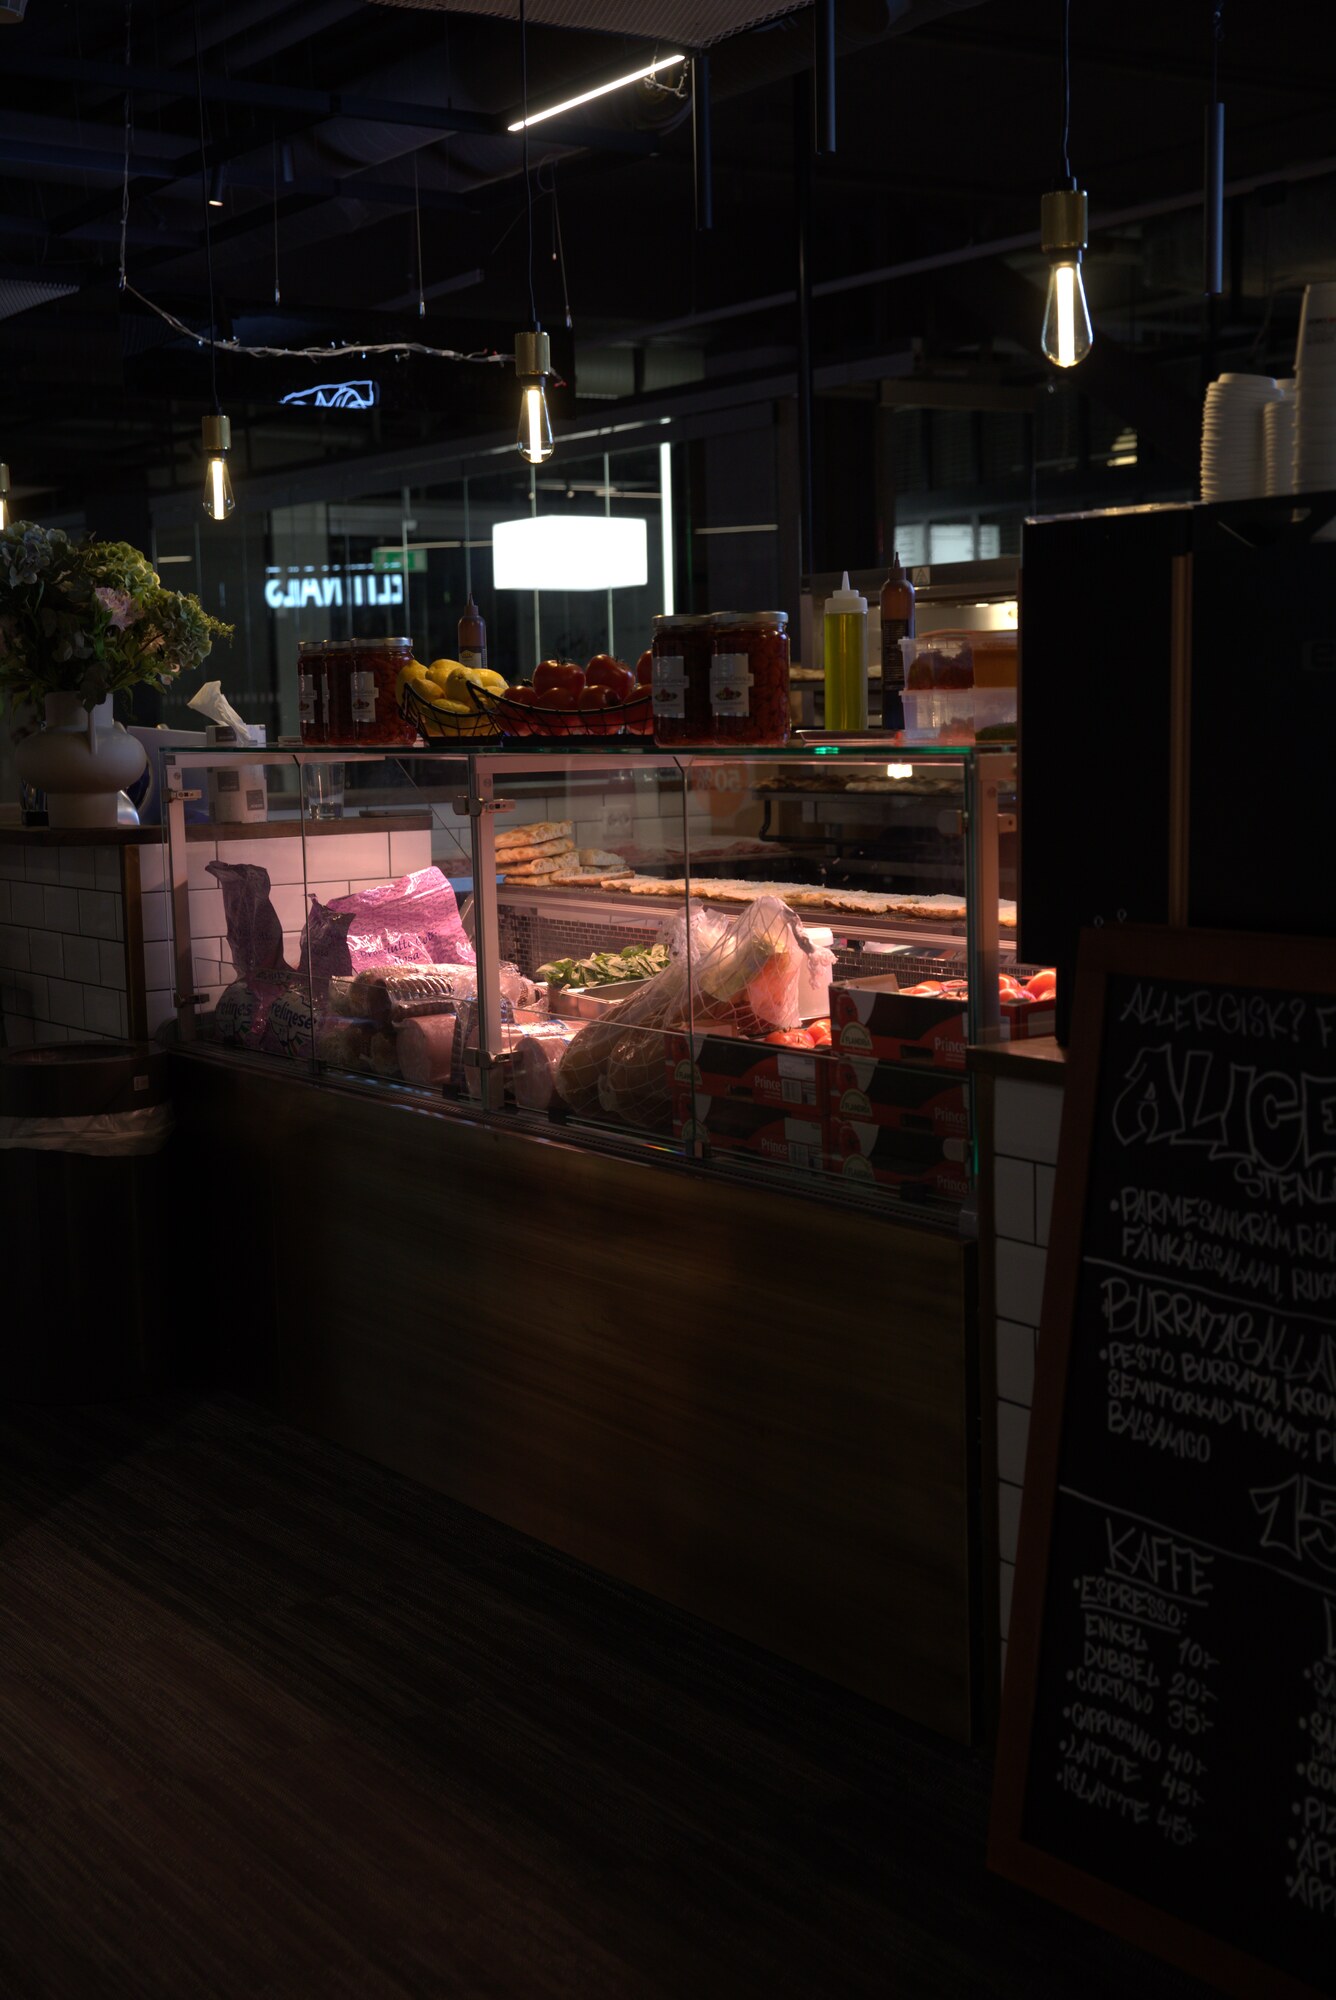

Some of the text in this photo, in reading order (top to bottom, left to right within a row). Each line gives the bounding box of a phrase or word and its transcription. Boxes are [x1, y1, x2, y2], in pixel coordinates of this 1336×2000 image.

[1119, 982, 1306, 1043] ALLERGISK?
[934, 1036, 966, 1054] Prince
[754, 1074, 781, 1092] Prince
[934, 1106, 966, 1124] Prince
[761, 1137, 788, 1155] Prince
[937, 1175, 969, 1194] Prince
[1234, 1159, 1336, 1206] STENL
[1108, 1341, 1177, 1379] PESTO,
[1108, 1370, 1233, 1425] SEMITORKAD
[1108, 1401, 1211, 1463] BALSAMICO
[1105, 1516, 1215, 1596] KAFFE
[1080, 1575, 1189, 1628] ESPRESSO:
[1085, 1612, 1149, 1652] ENKEL
[1084, 1640, 1160, 1688] DUBBEL
[1075, 1667, 1153, 1714] CORTADO
[1064, 1733, 1142, 1784] LATTE
[1062, 1764, 1150, 1825] ISLATTE
